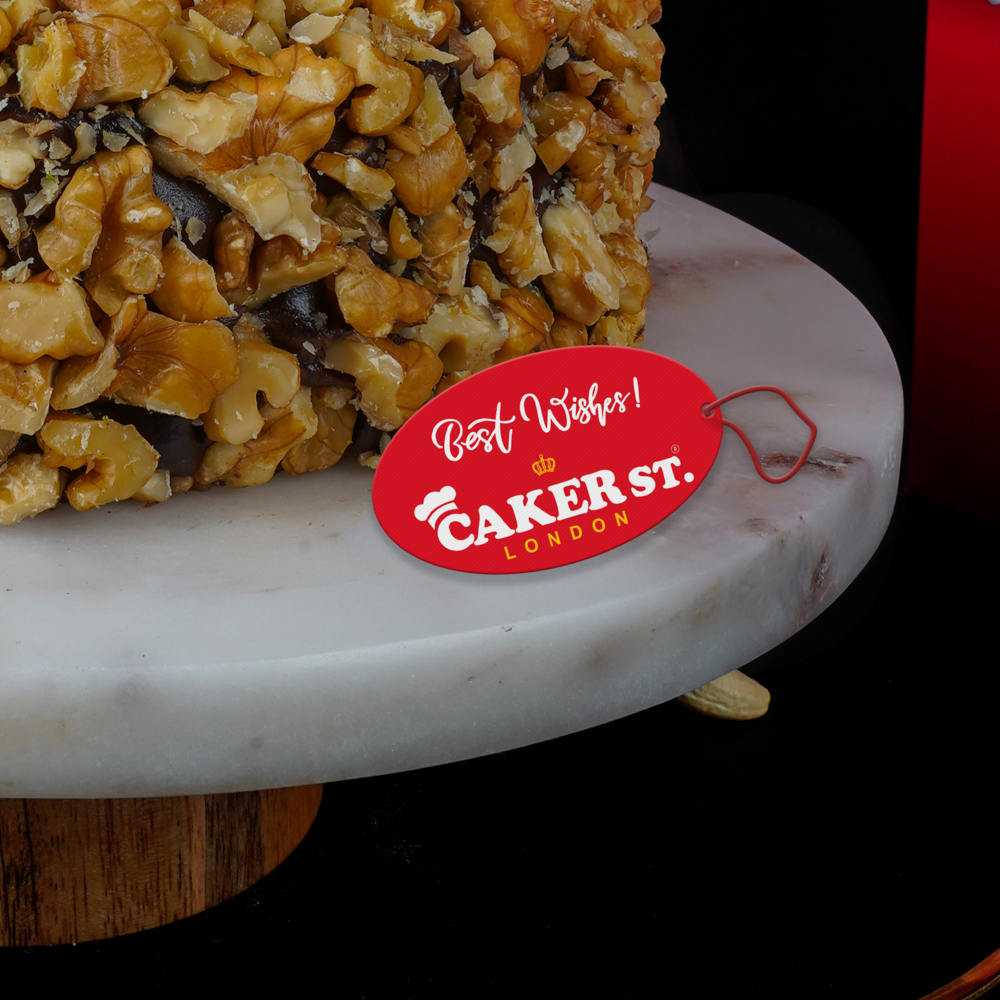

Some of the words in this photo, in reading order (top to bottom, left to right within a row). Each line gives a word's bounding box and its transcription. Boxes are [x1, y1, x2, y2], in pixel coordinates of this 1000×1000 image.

[431, 401, 516, 462] Best
[520, 377, 642, 433] Wishes!
[437, 469, 627, 552] CAKER
[628, 455, 694, 498] ST.
[504, 509, 630, 561] LONDON
